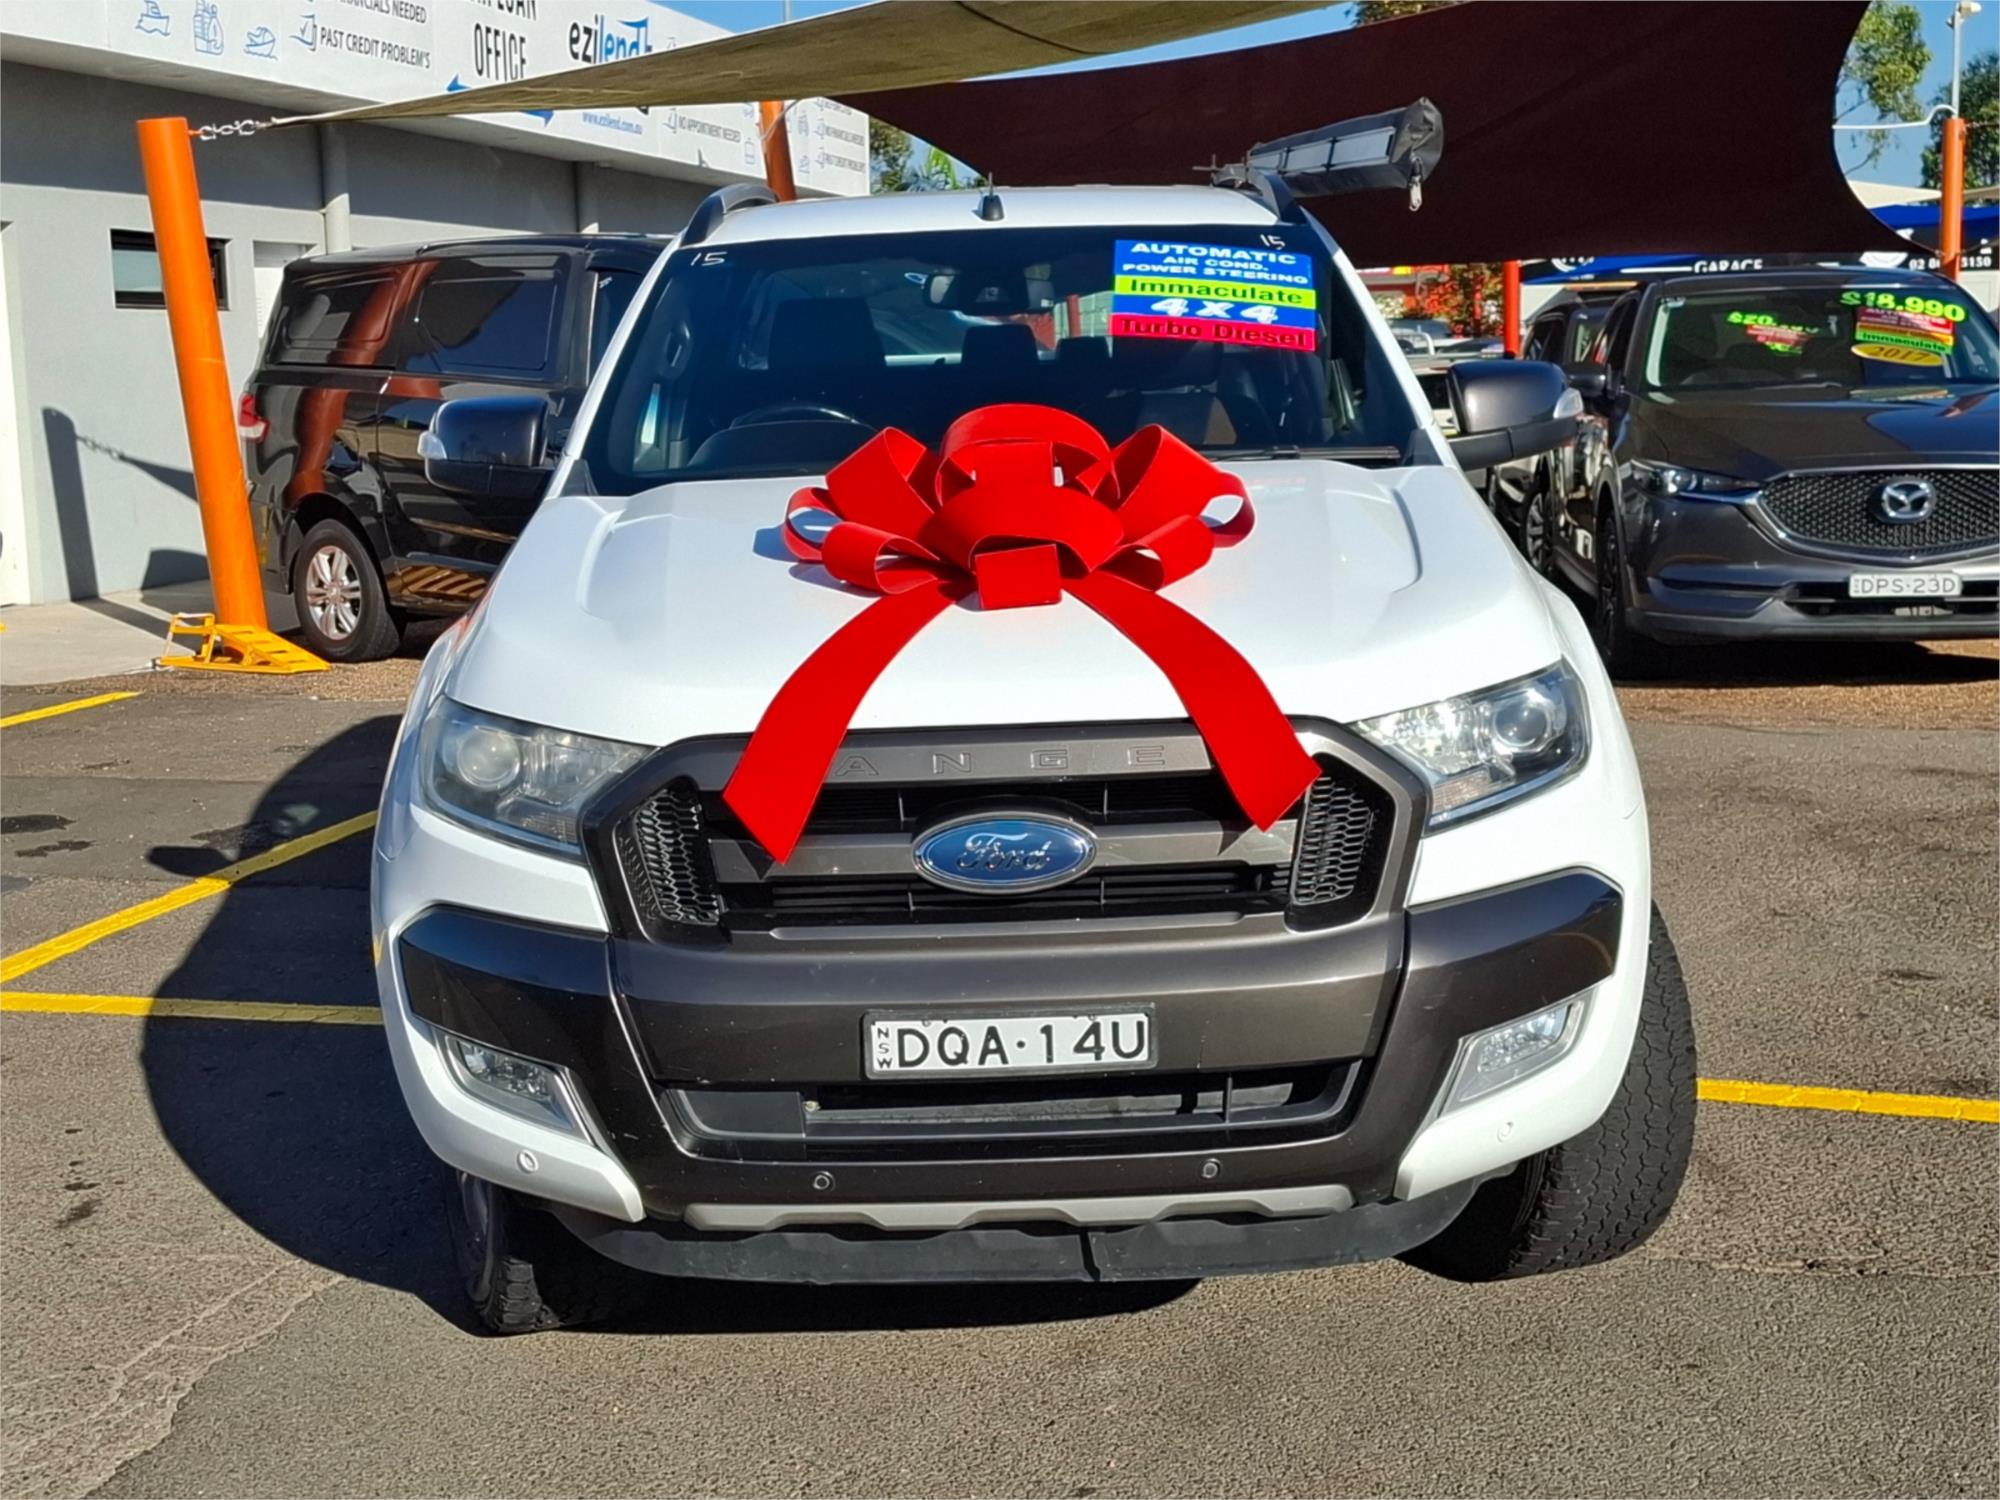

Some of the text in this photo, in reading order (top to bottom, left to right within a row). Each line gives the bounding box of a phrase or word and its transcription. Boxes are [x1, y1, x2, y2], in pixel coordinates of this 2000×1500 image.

[392, 0, 427, 24] NEEDED
[320, 26, 431, 69] PAST CREDIT PROBLEM'S
[1131, 242, 1297, 265] AUTOMATIC
[1163, 256, 1269, 272] AIR COND.
[1122, 263, 1309, 284] POWER STEERING
[1694, 258, 1763, 273] GARAGE
[1131, 279, 1303, 304] Immaculate
[1121, 317, 1306, 346] Turbo Diesel
[1869, 346, 1931, 361] 2017
[955, 831, 1053, 872] Ford
